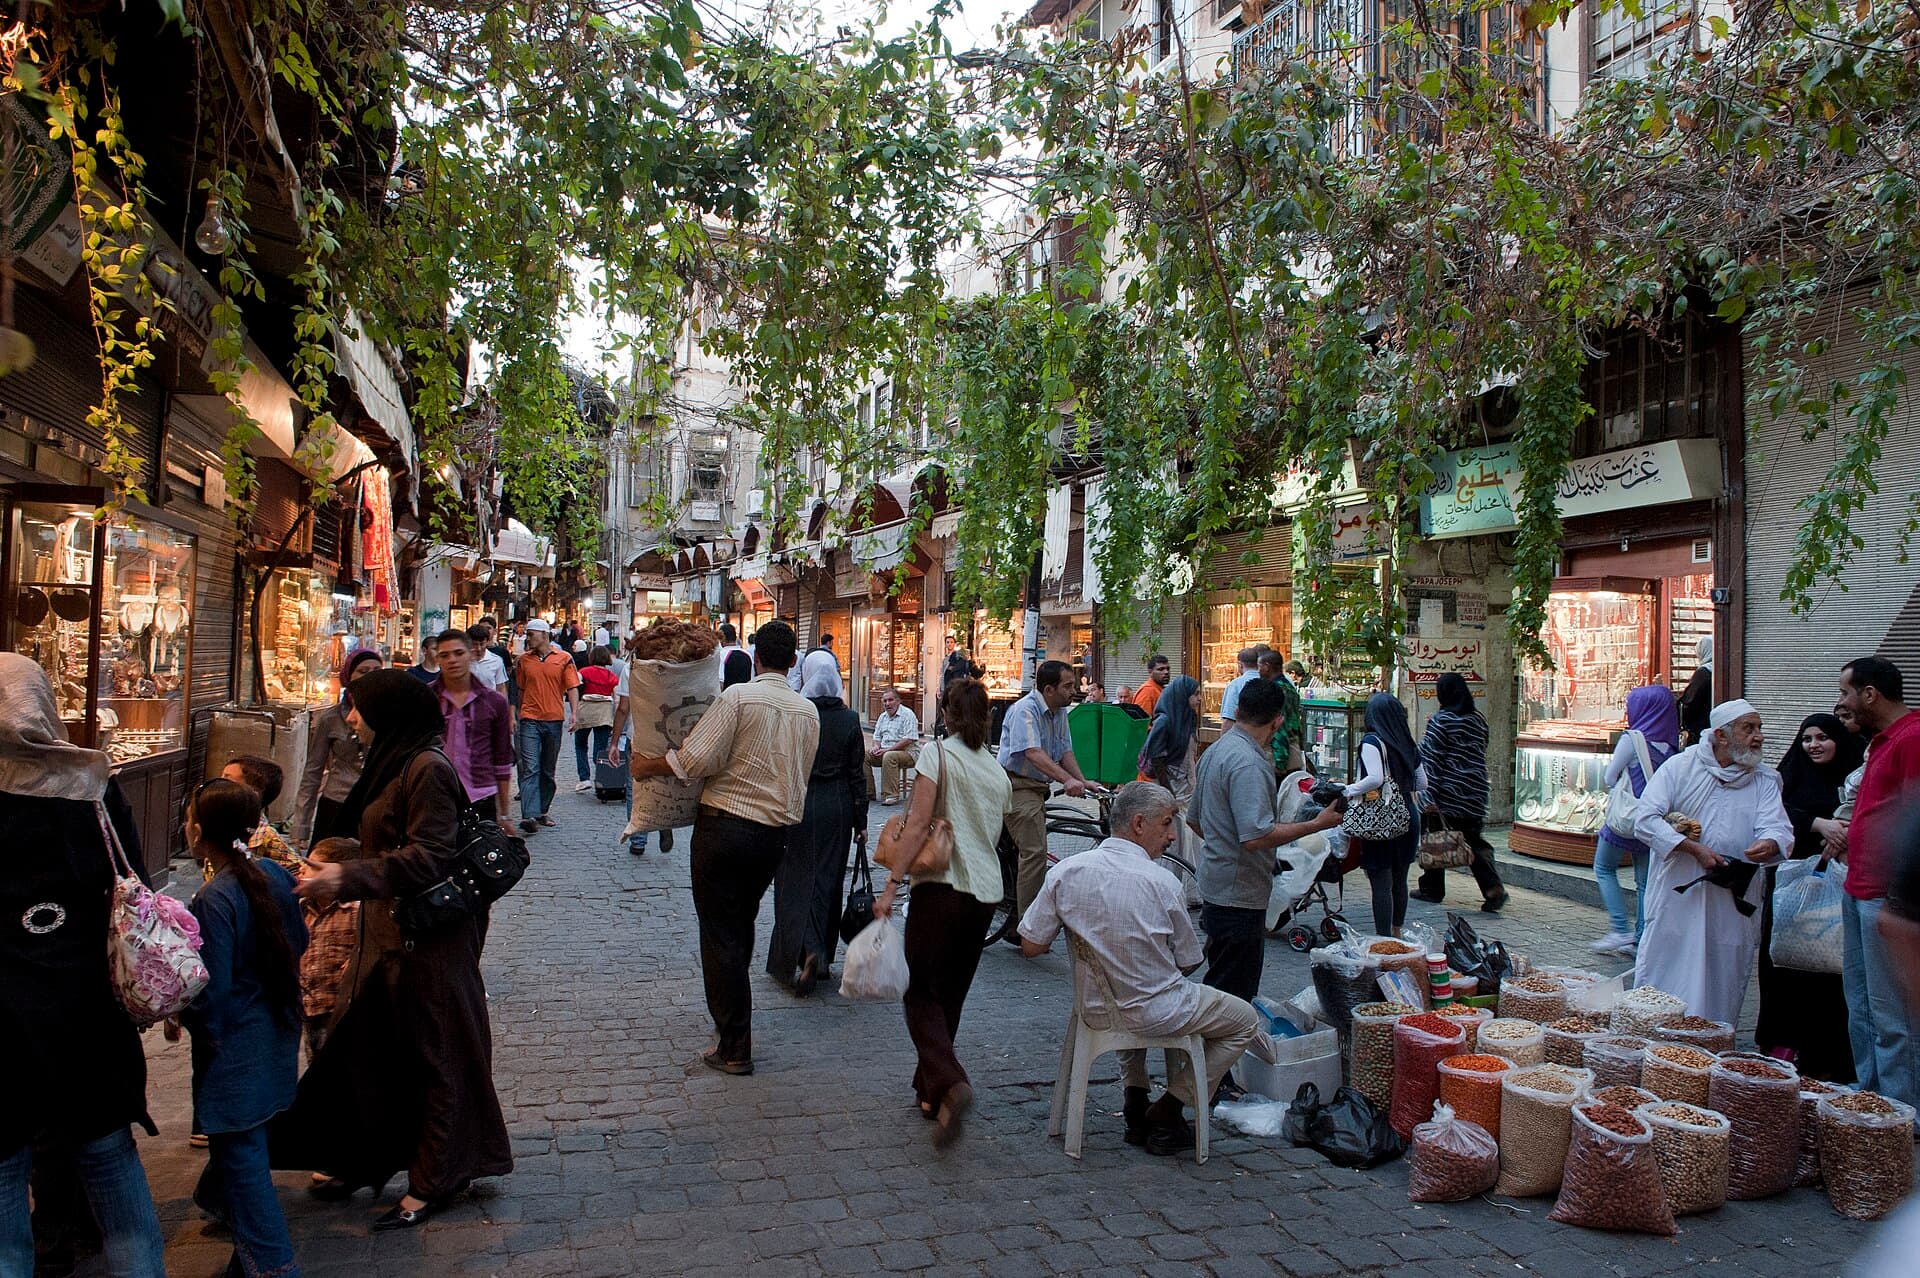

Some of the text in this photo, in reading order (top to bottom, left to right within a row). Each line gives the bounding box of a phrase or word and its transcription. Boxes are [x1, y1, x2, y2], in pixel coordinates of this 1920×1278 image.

[1561, 463, 1604, 499] نبيل
[1602, 455, 1660, 490] عزت
[1445, 499, 1473, 515] لوحات
[1474, 497, 1502, 514] مخمل
[1416, 577, 1463, 586] PAPA JOSEPH
[1409, 640, 1481, 660] ابو مروان
[1418, 660, 1446, 672] ذهب
